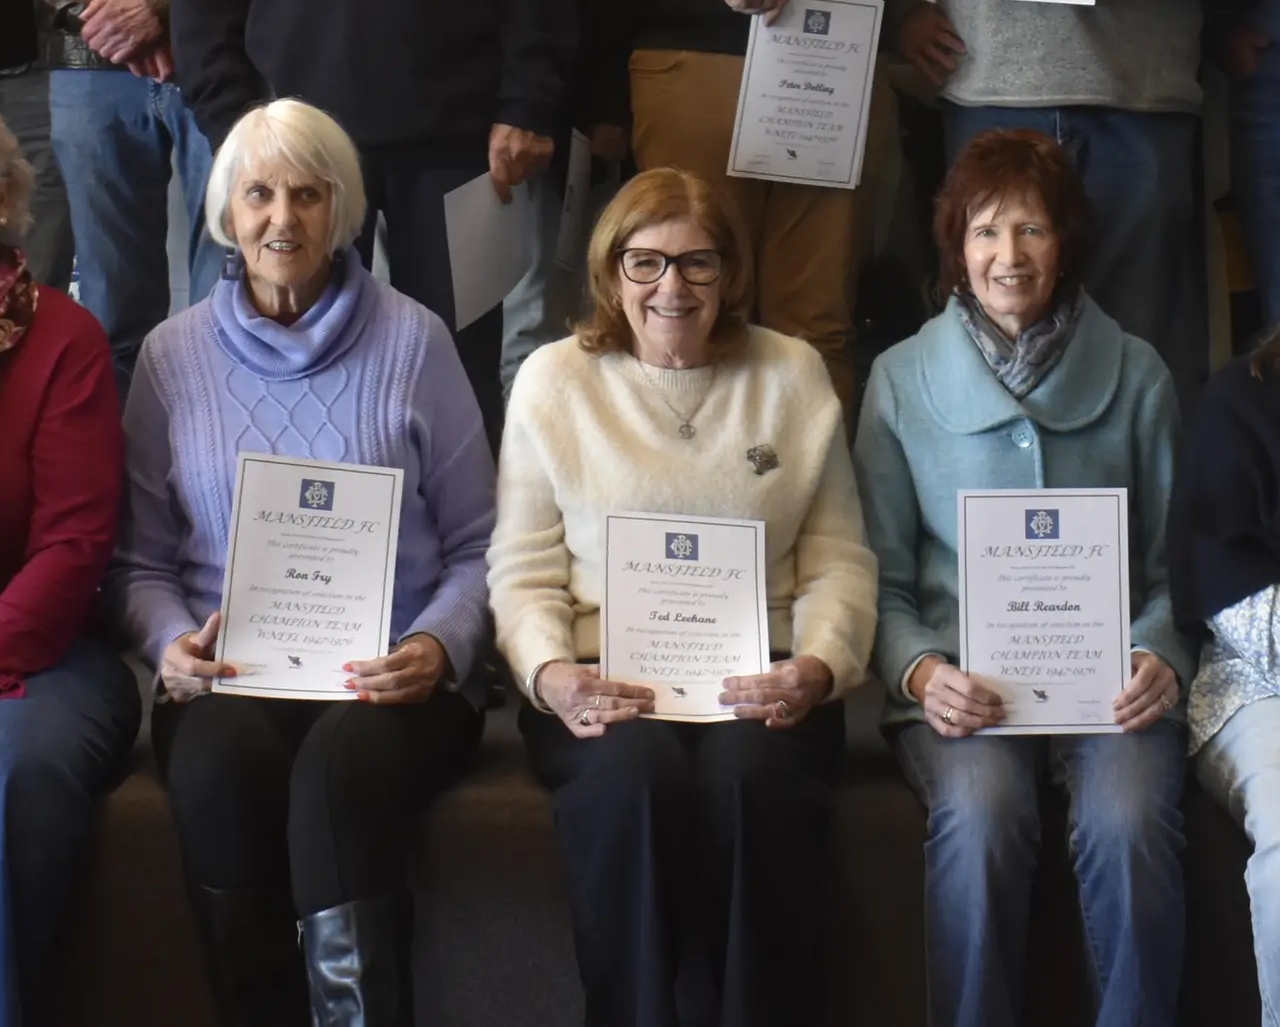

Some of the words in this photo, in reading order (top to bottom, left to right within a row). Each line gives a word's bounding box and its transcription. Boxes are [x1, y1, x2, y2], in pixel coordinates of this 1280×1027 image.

[252, 509, 355, 530] MANSFIELD
[354, 519, 380, 534] FC
[980, 544, 1083, 559] MANSFIELD
[1083, 543, 1109, 559] FC
[284, 567, 308, 580] Ron
[310, 569, 332, 585] Fry
[620, 560, 722, 577] MANSFIELD
[722, 567, 747, 580] FC
[269, 600, 345, 615] MANSFIELD
[1006, 600, 1030, 612] Bill
[1032, 600, 1080, 612] Reardon
[248, 613, 320, 628] CHAMPION
[323, 619, 362, 632] TEAM
[648, 610, 670, 621] Ted
[672, 612, 716, 624] Leehane
[1008, 633, 1085, 645] MANSFIELD
[989, 649, 1061, 661] CHAMPION
[1065, 648, 1103, 659] TEAM
